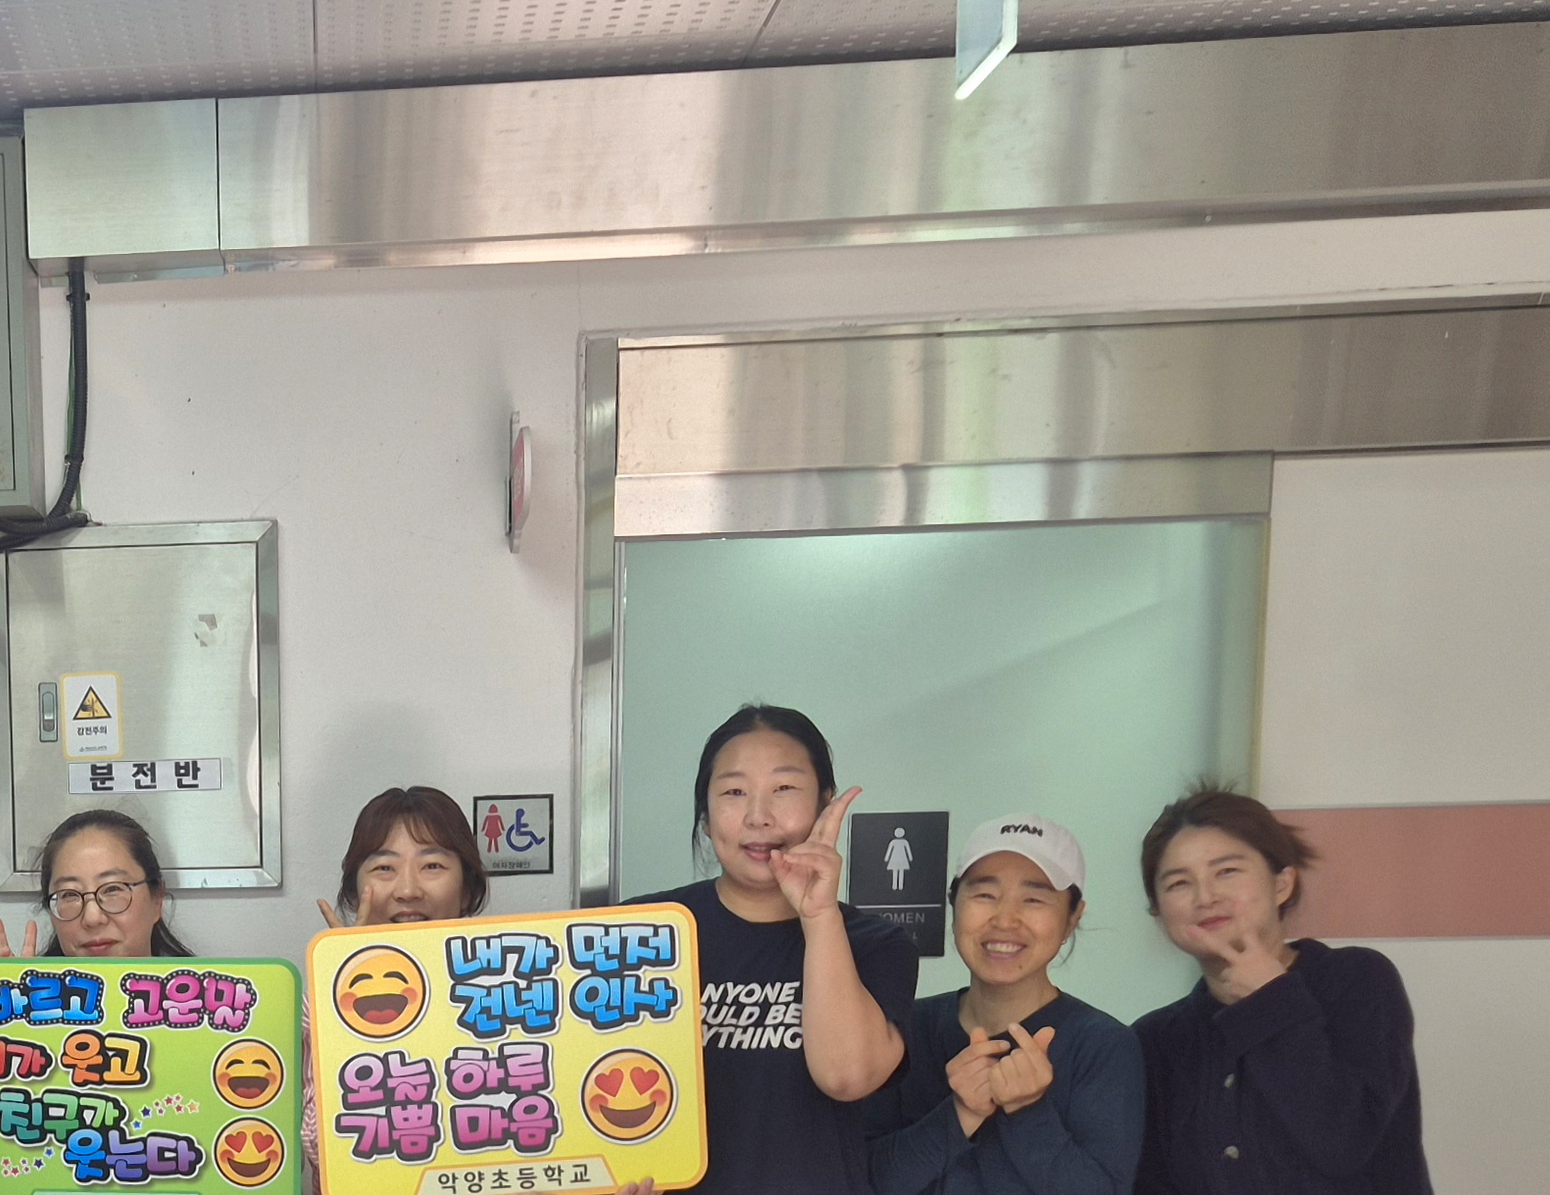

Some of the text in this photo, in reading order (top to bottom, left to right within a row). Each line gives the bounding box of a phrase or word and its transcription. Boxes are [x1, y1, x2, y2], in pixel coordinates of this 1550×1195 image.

[879, 912, 925, 923] OMEN
[445, 923, 678, 981] 내가 먼저
[120, 969, 258, 1032] 고운말
[451, 974, 680, 1040] 건넨 인사
[701, 982, 800, 1004] NYONE
[764, 1003, 802, 1025] BE
[59, 1030, 152, 1087] 웃고
[702, 1024, 803, 1050] YTHING
[339, 1042, 553, 1111] 오늘 하루
[335, 1093, 564, 1164] 기쁨 마음
[63, 1129, 205, 1185] 웃는다
[438, 1164, 592, 1194] 악양초등학교
